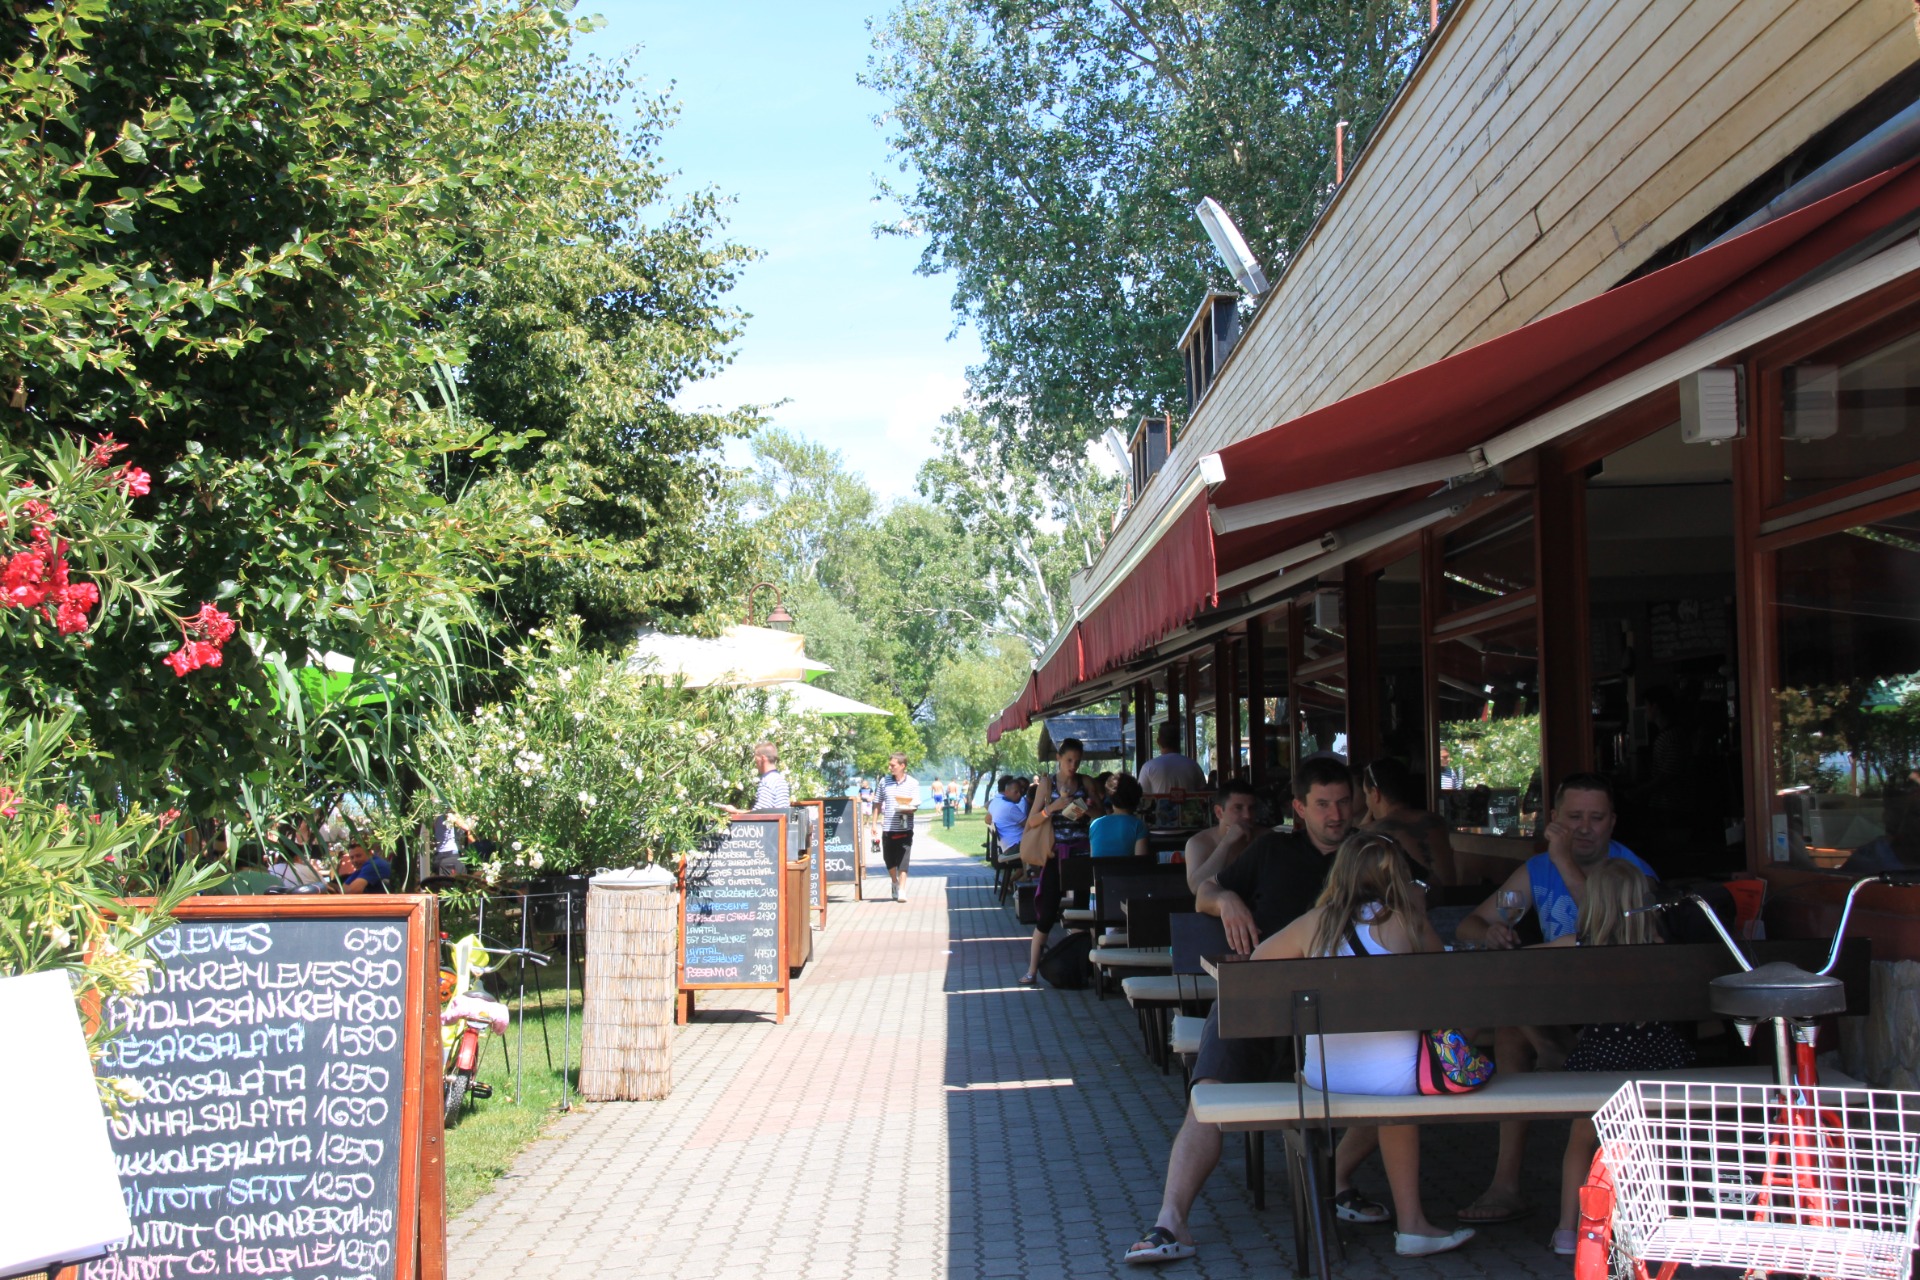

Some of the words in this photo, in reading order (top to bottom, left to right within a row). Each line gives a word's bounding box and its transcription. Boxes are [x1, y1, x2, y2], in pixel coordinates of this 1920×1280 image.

[146, 923, 273, 959] SLEVES
[344, 926, 402, 955] 650
[137, 955, 352, 994] AJTKRÉMLEVES
[351, 956, 402, 989] 950
[354, 990, 401, 1023] 800
[322, 1022, 397, 1056] 1590
[106, 1060, 306, 1107] RÖGSALÁTA
[317, 1061, 389, 1093] 1350
[313, 1094, 388, 1127] 1690
[114, 1131, 313, 1176] UKKOLASALÁTA
[316, 1131, 384, 1165] 1350
[123, 1180, 226, 1217] ÁNTOTT
[226, 1174, 307, 1205] SAJT
[302, 1171, 375, 1202] 1250
[106, 1219, 214, 1252] NTOTT
[333, 1239, 390, 1272] 1350
